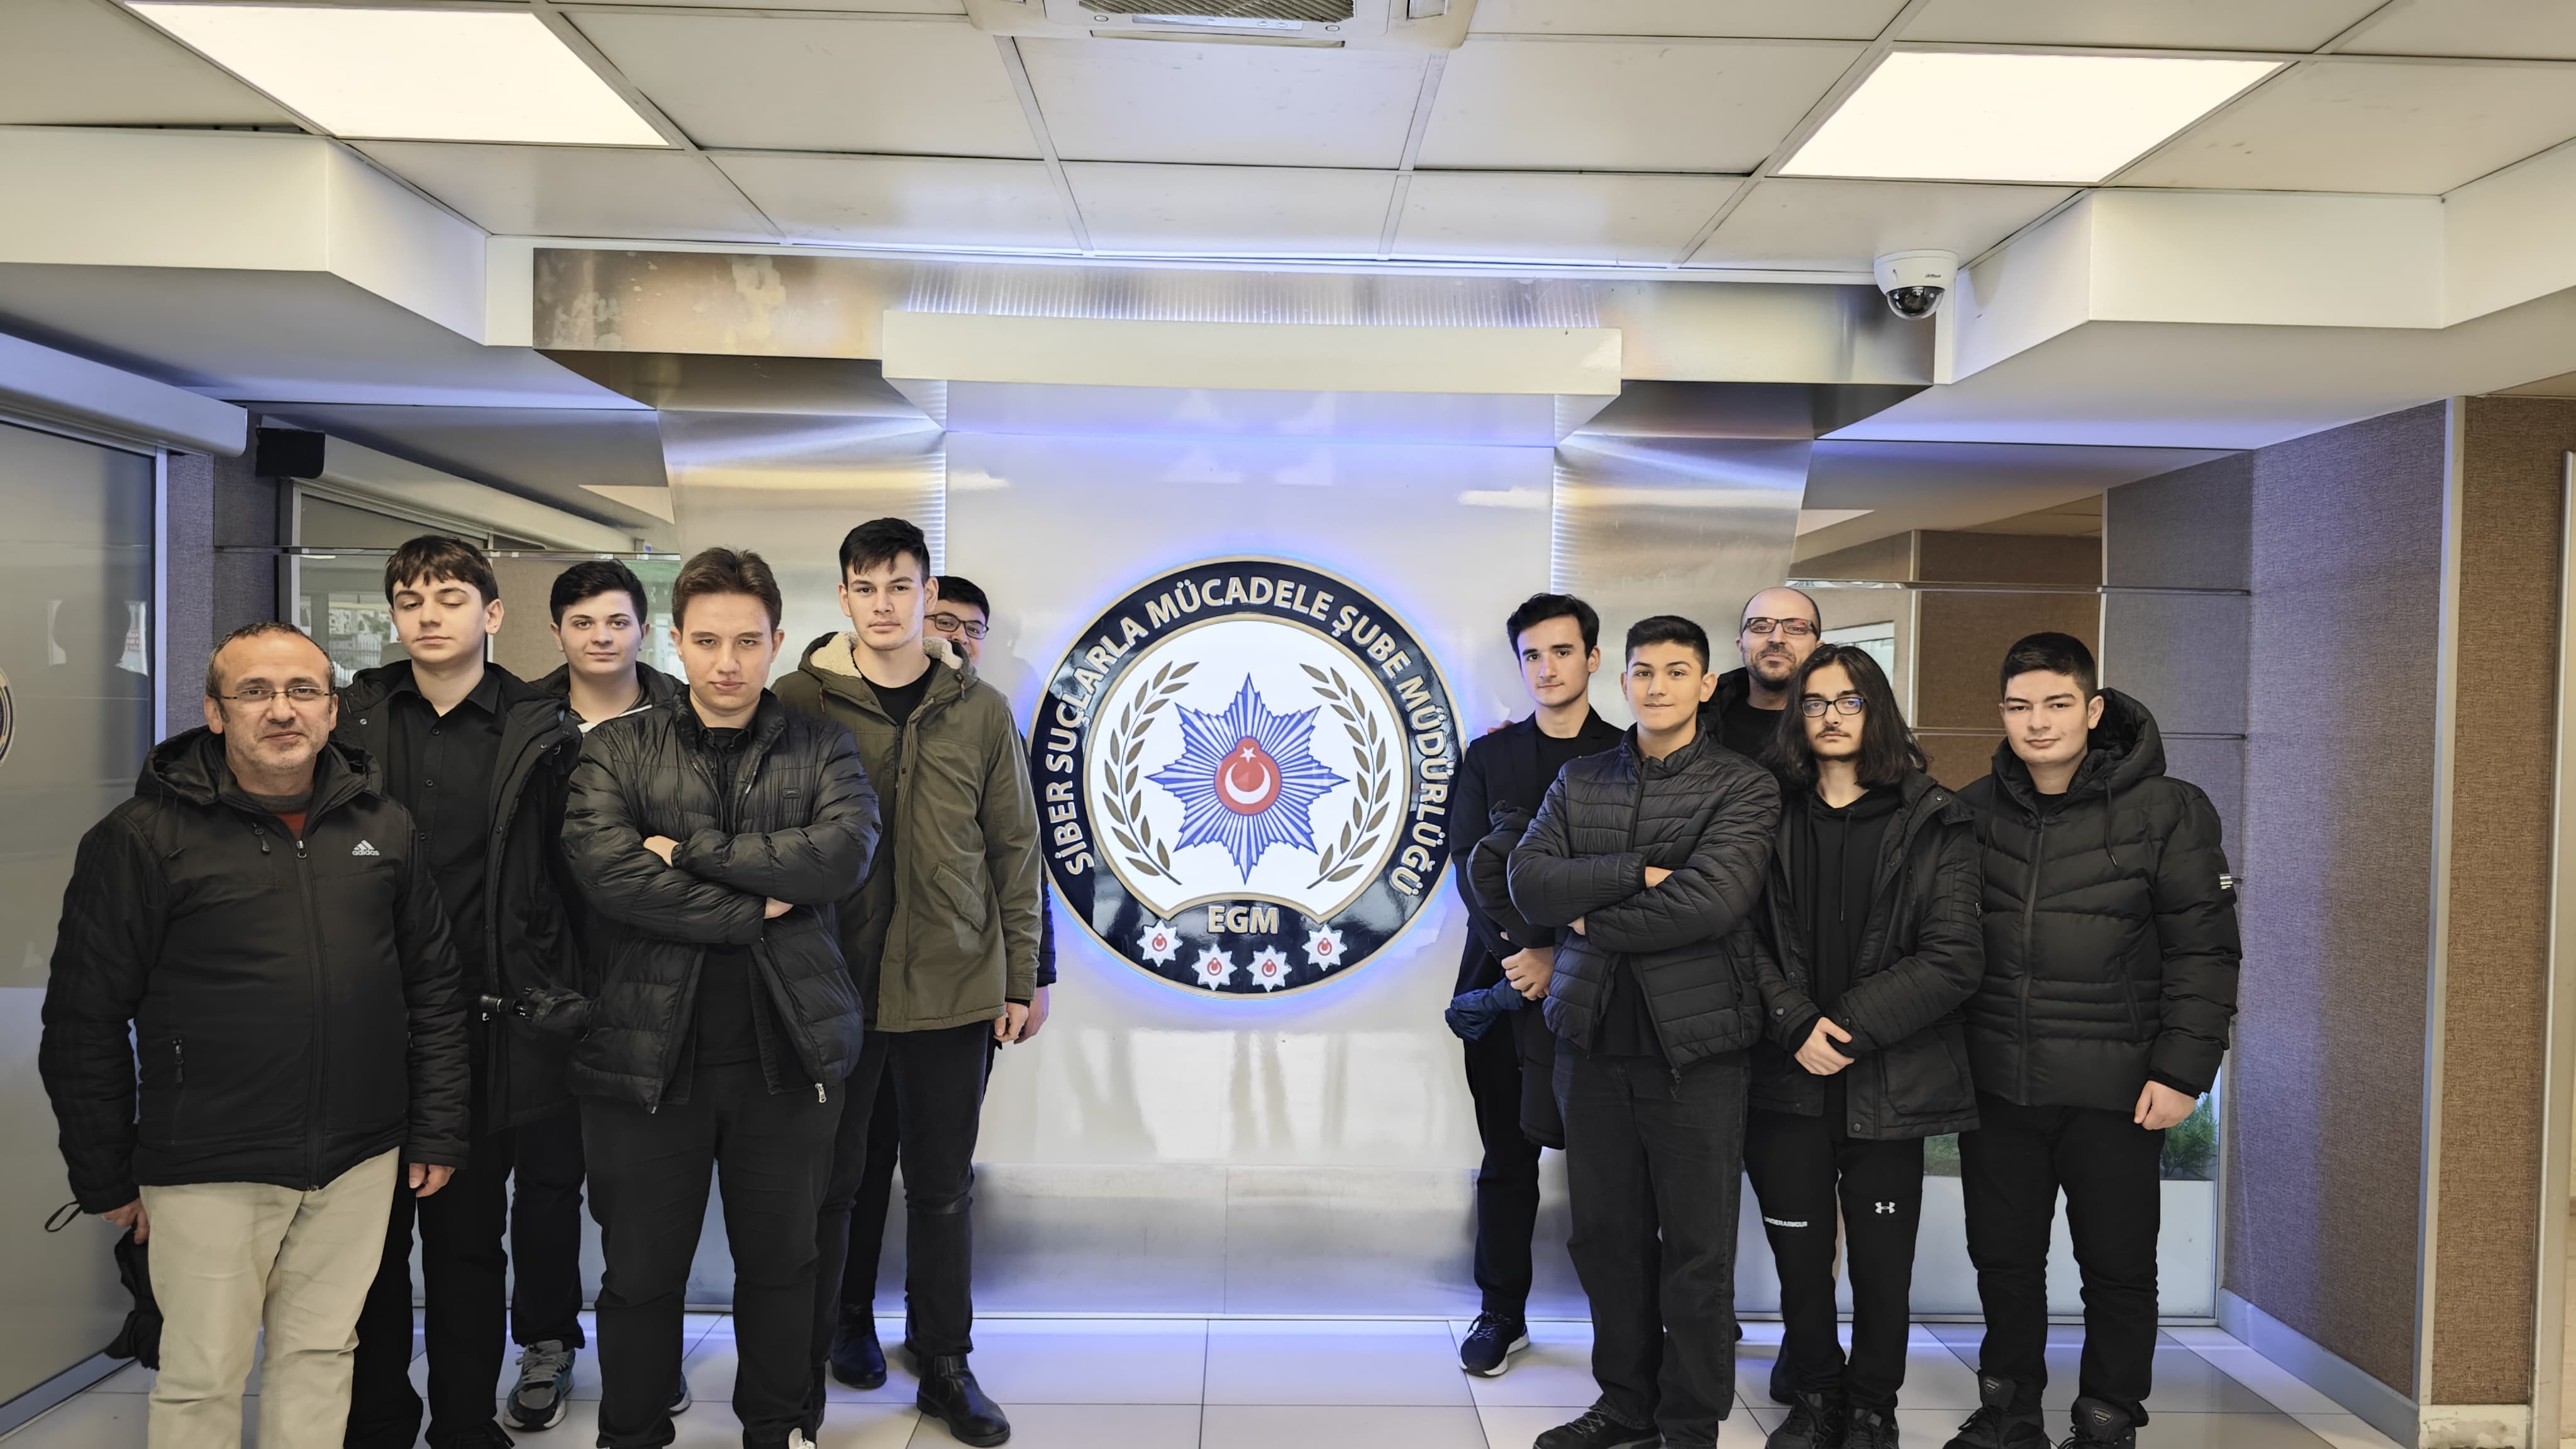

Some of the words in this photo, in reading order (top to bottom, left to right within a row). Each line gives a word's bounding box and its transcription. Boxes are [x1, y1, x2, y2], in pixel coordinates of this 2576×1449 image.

[1145, 576, 1335, 630] MÜCADELE
[1331, 604, 1413, 680] ŞUBE
[1045, 616, 1149, 774] SUÇLARLA
[1045, 780, 1095, 875] SİBER
[1389, 675, 1454, 896] MÜDÜRLÜĞÜ
[1207, 904, 1279, 935] EGM
